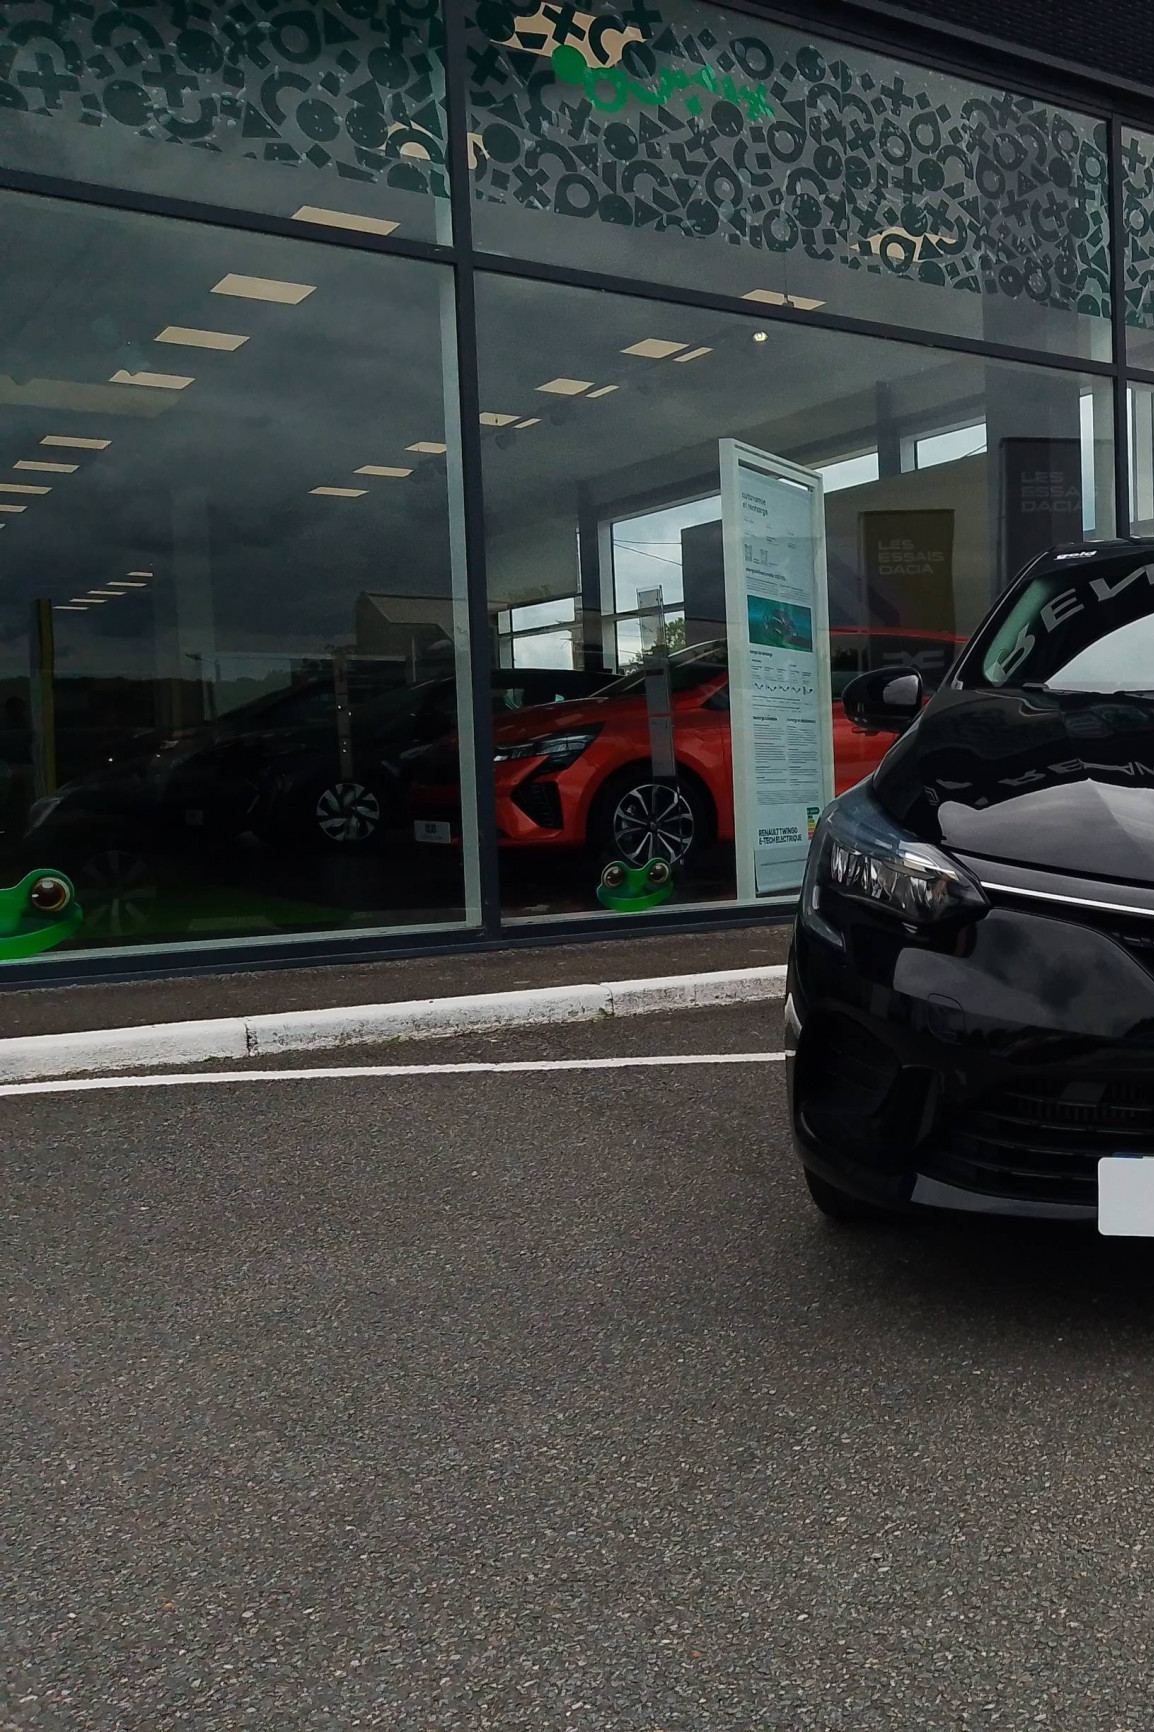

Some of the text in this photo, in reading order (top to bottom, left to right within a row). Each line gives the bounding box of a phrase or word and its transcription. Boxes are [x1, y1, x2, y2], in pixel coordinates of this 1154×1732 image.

[1021, 471, 1064, 483] LES
[1020, 485, 1080, 498] ESSA
[878, 540, 914, 550] LES
[877, 551, 945, 562] ESSAIS
[878, 564, 934, 575] DACIA
[758, 828, 779, 837] RENAULT
